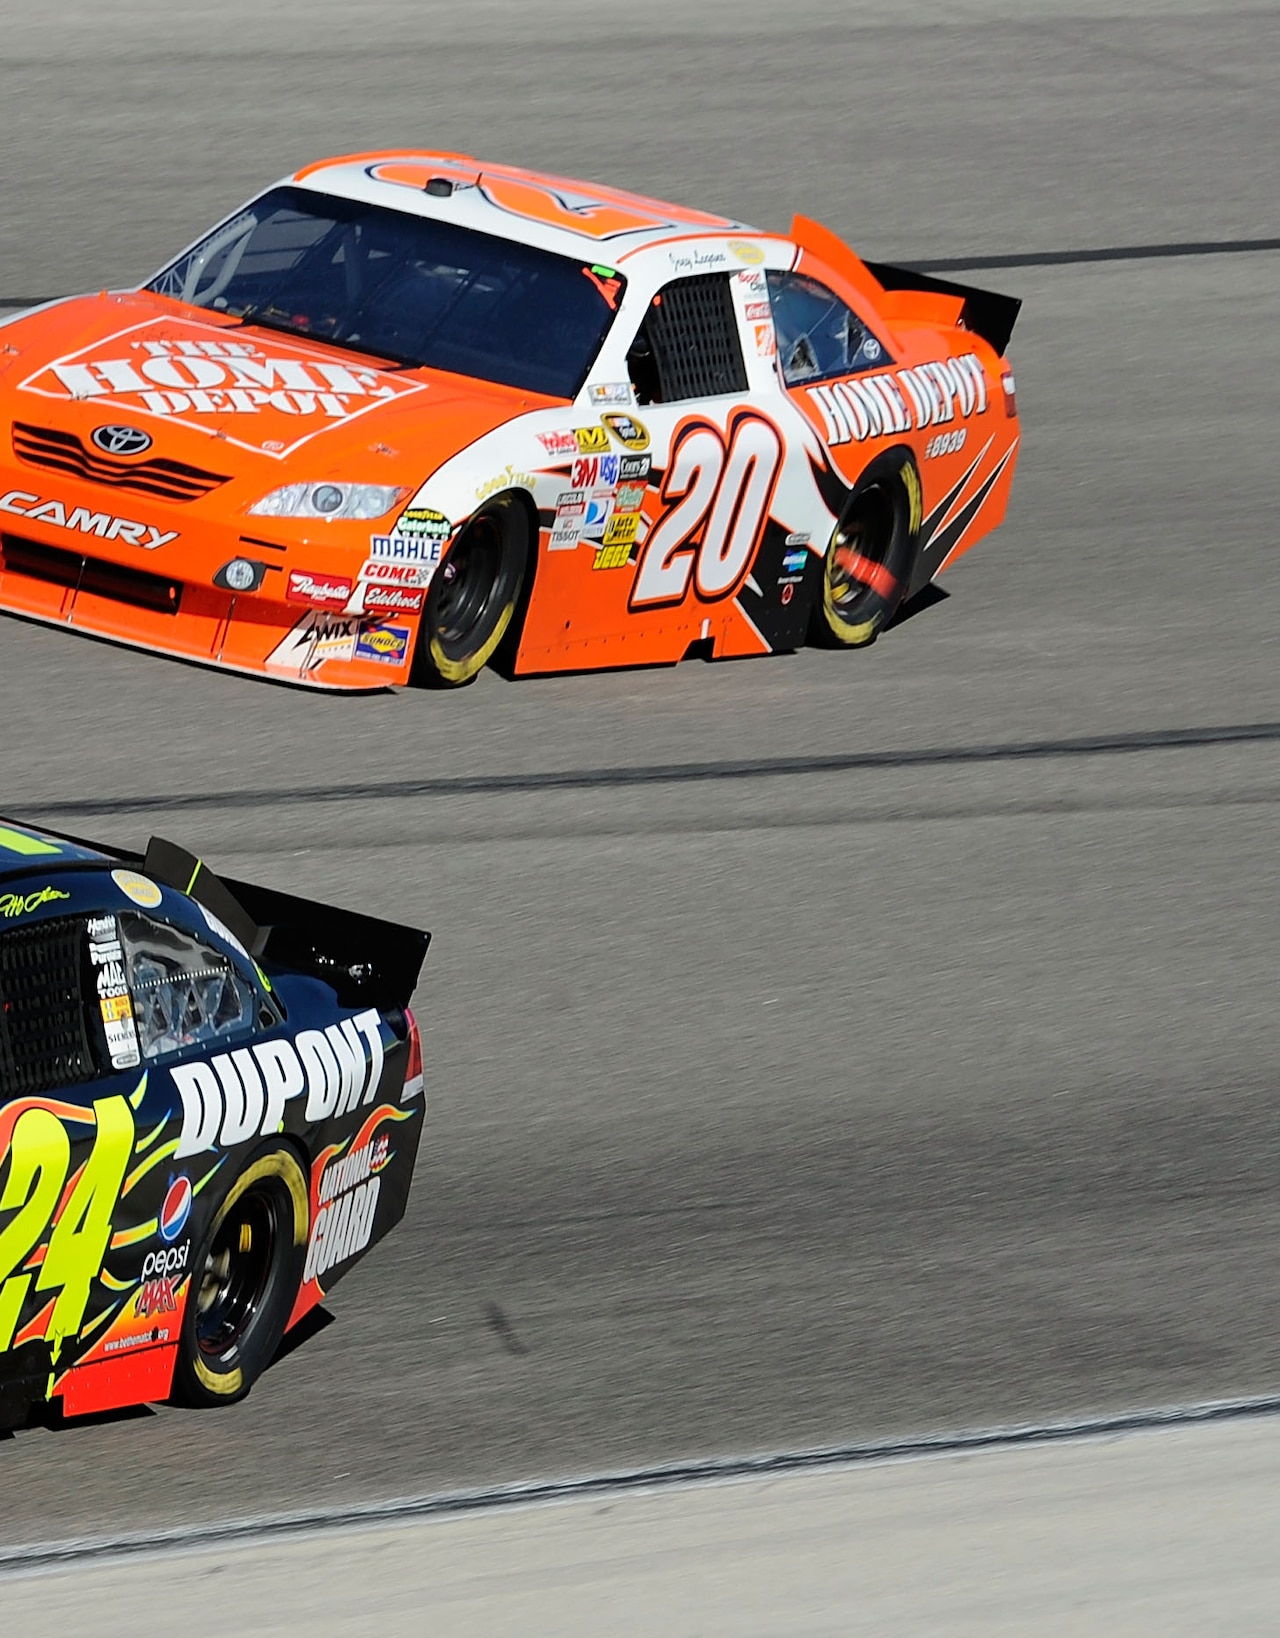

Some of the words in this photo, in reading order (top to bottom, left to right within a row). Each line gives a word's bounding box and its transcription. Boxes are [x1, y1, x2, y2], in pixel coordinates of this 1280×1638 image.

[131, 339, 266, 358] THE
[51, 356, 396, 397] HOME
[139, 390, 352, 418] DEPOT
[806, 373, 912, 446] HOME
[896, 353, 987, 430] DEPOT
[925, 428, 968, 459] #8939
[571, 456, 598, 489] 3M
[628, 405, 787, 613] 20
[397, 516, 451, 535] Gatorback
[372, 537, 441, 561] MAHLE
[363, 563, 417, 580] COMP
[365, 586, 421, 609] Edelbrock
[362, 634, 405, 651] SUNOCO
[98, 984, 129, 999] TOOLS
[169, 1007, 385, 1160] DUPONT
[317, 1139, 375, 1207] NATIONAL
[302, 1175, 381, 1284] GUARD
[141, 1238, 191, 1283] pepsi
[134, 1273, 184, 1319] MAX
